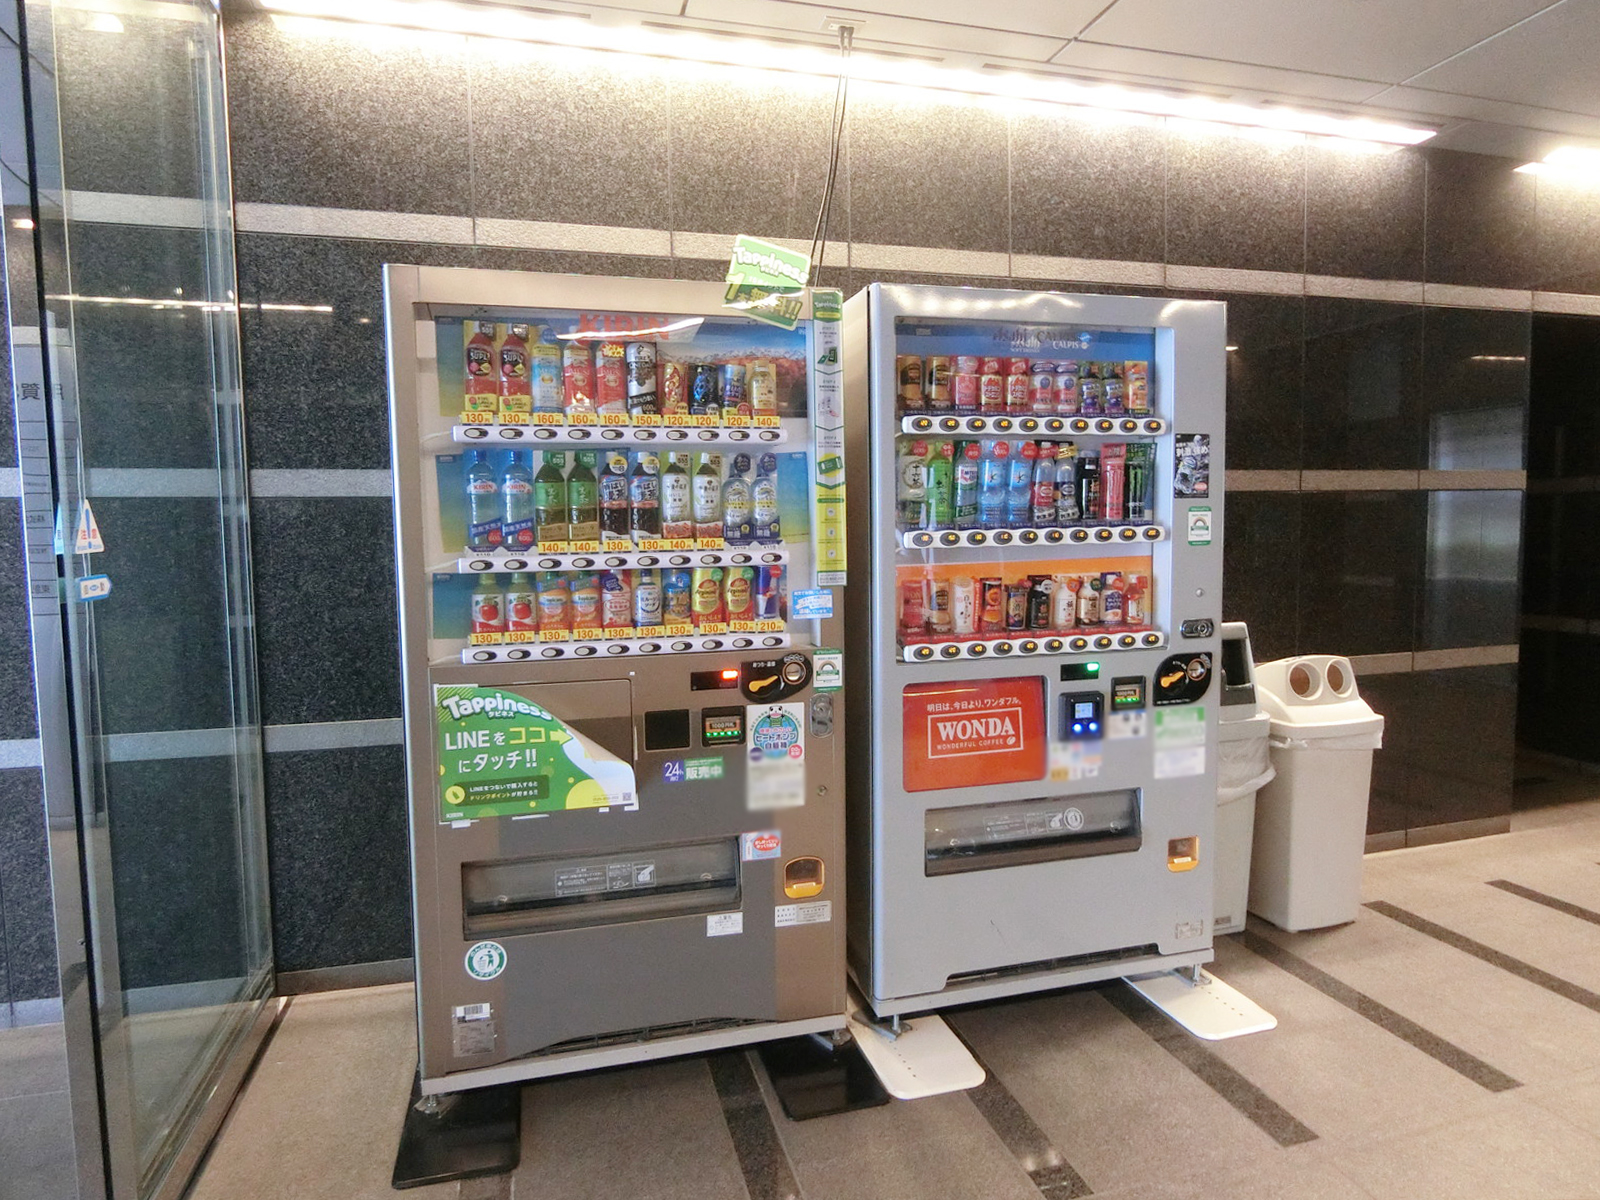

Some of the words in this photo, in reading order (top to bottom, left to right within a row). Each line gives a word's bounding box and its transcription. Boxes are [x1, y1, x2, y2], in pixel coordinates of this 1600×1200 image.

[732, 246, 809, 285] Tappiness
[1053, 341, 1079, 350] CALPIS
[442, 693, 552, 720] Tappiness
[488, 710, 515, 718] タピネス
[937, 716, 1015, 742] WONDA
[937, 741, 977, 751] WONDERFUL
[978, 738, 1004, 747] COFFEE
[685, 765, 723, 780] 販売中
